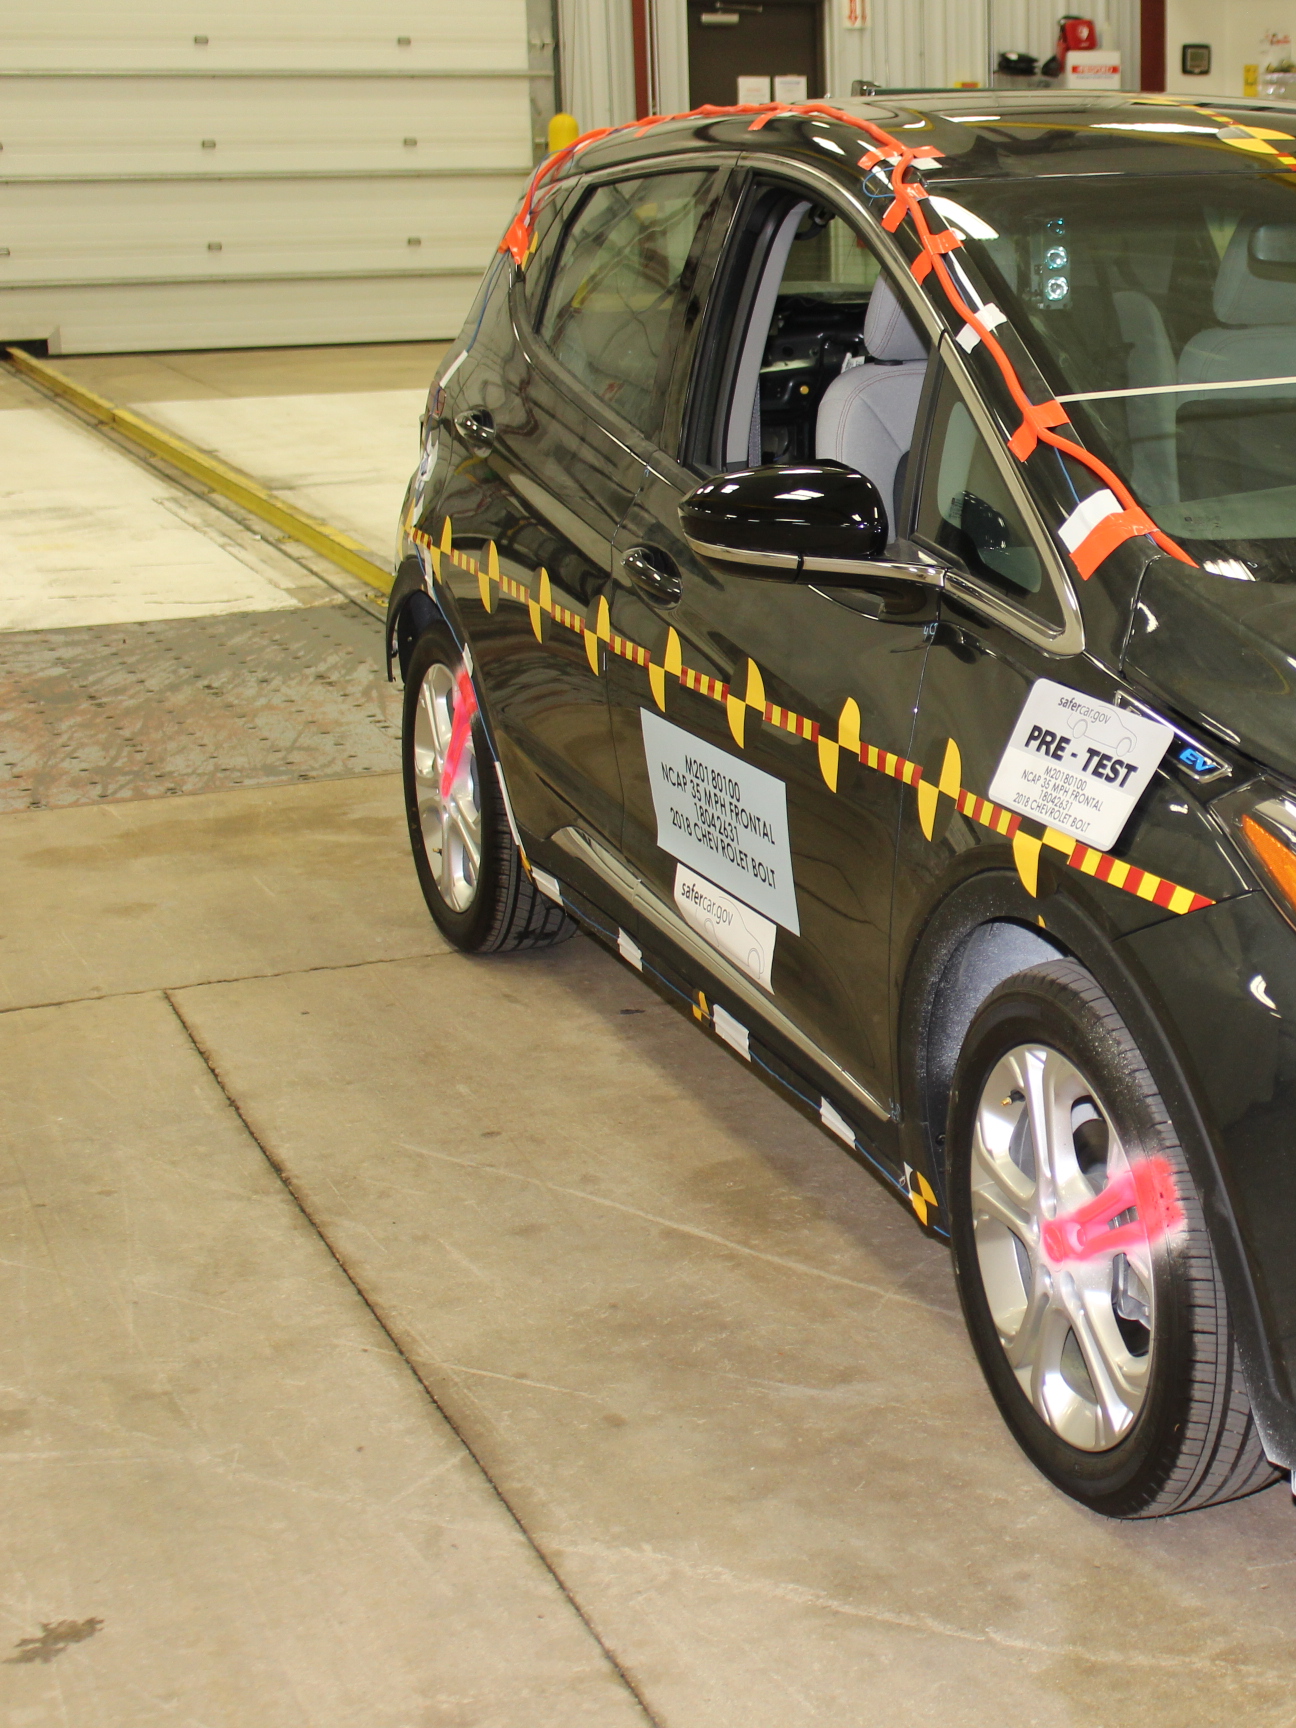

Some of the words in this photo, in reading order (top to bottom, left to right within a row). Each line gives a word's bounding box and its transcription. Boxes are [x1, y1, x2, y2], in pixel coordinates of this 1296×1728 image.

[1057, 694, 1112, 725] safercar.gov
[685, 754, 741, 803] M20180100
[1024, 724, 1071, 762] PRE
[1081, 747, 1139, 789] TEST
[1043, 765, 1087, 792] M20180100
[1179, 748, 1216, 771] EV
[661, 761, 688, 793] NCAP
[690, 779, 702, 802] 35
[704, 786, 727, 817] MPH
[728, 800, 776, 845] FRONTAL
[1020, 768, 1041, 785] NCAP
[1040, 777, 1052, 790] 35
[1050, 781, 1070, 798] MPH
[1069, 789, 1104, 812] FRONTAL
[1038, 789, 1073, 812] 18042631
[694, 802, 740, 846] 18042631
[1012, 792, 1031, 808] 2018
[1029, 799, 1072, 826] CHEVROLET
[1070, 816, 1091, 833] BOLT
[670, 806, 693, 837] 2018
[693, 822, 750, 873] CHEVROLET
[751, 857, 776, 890] BOLT
[681, 881, 734, 927] safercar.gov
